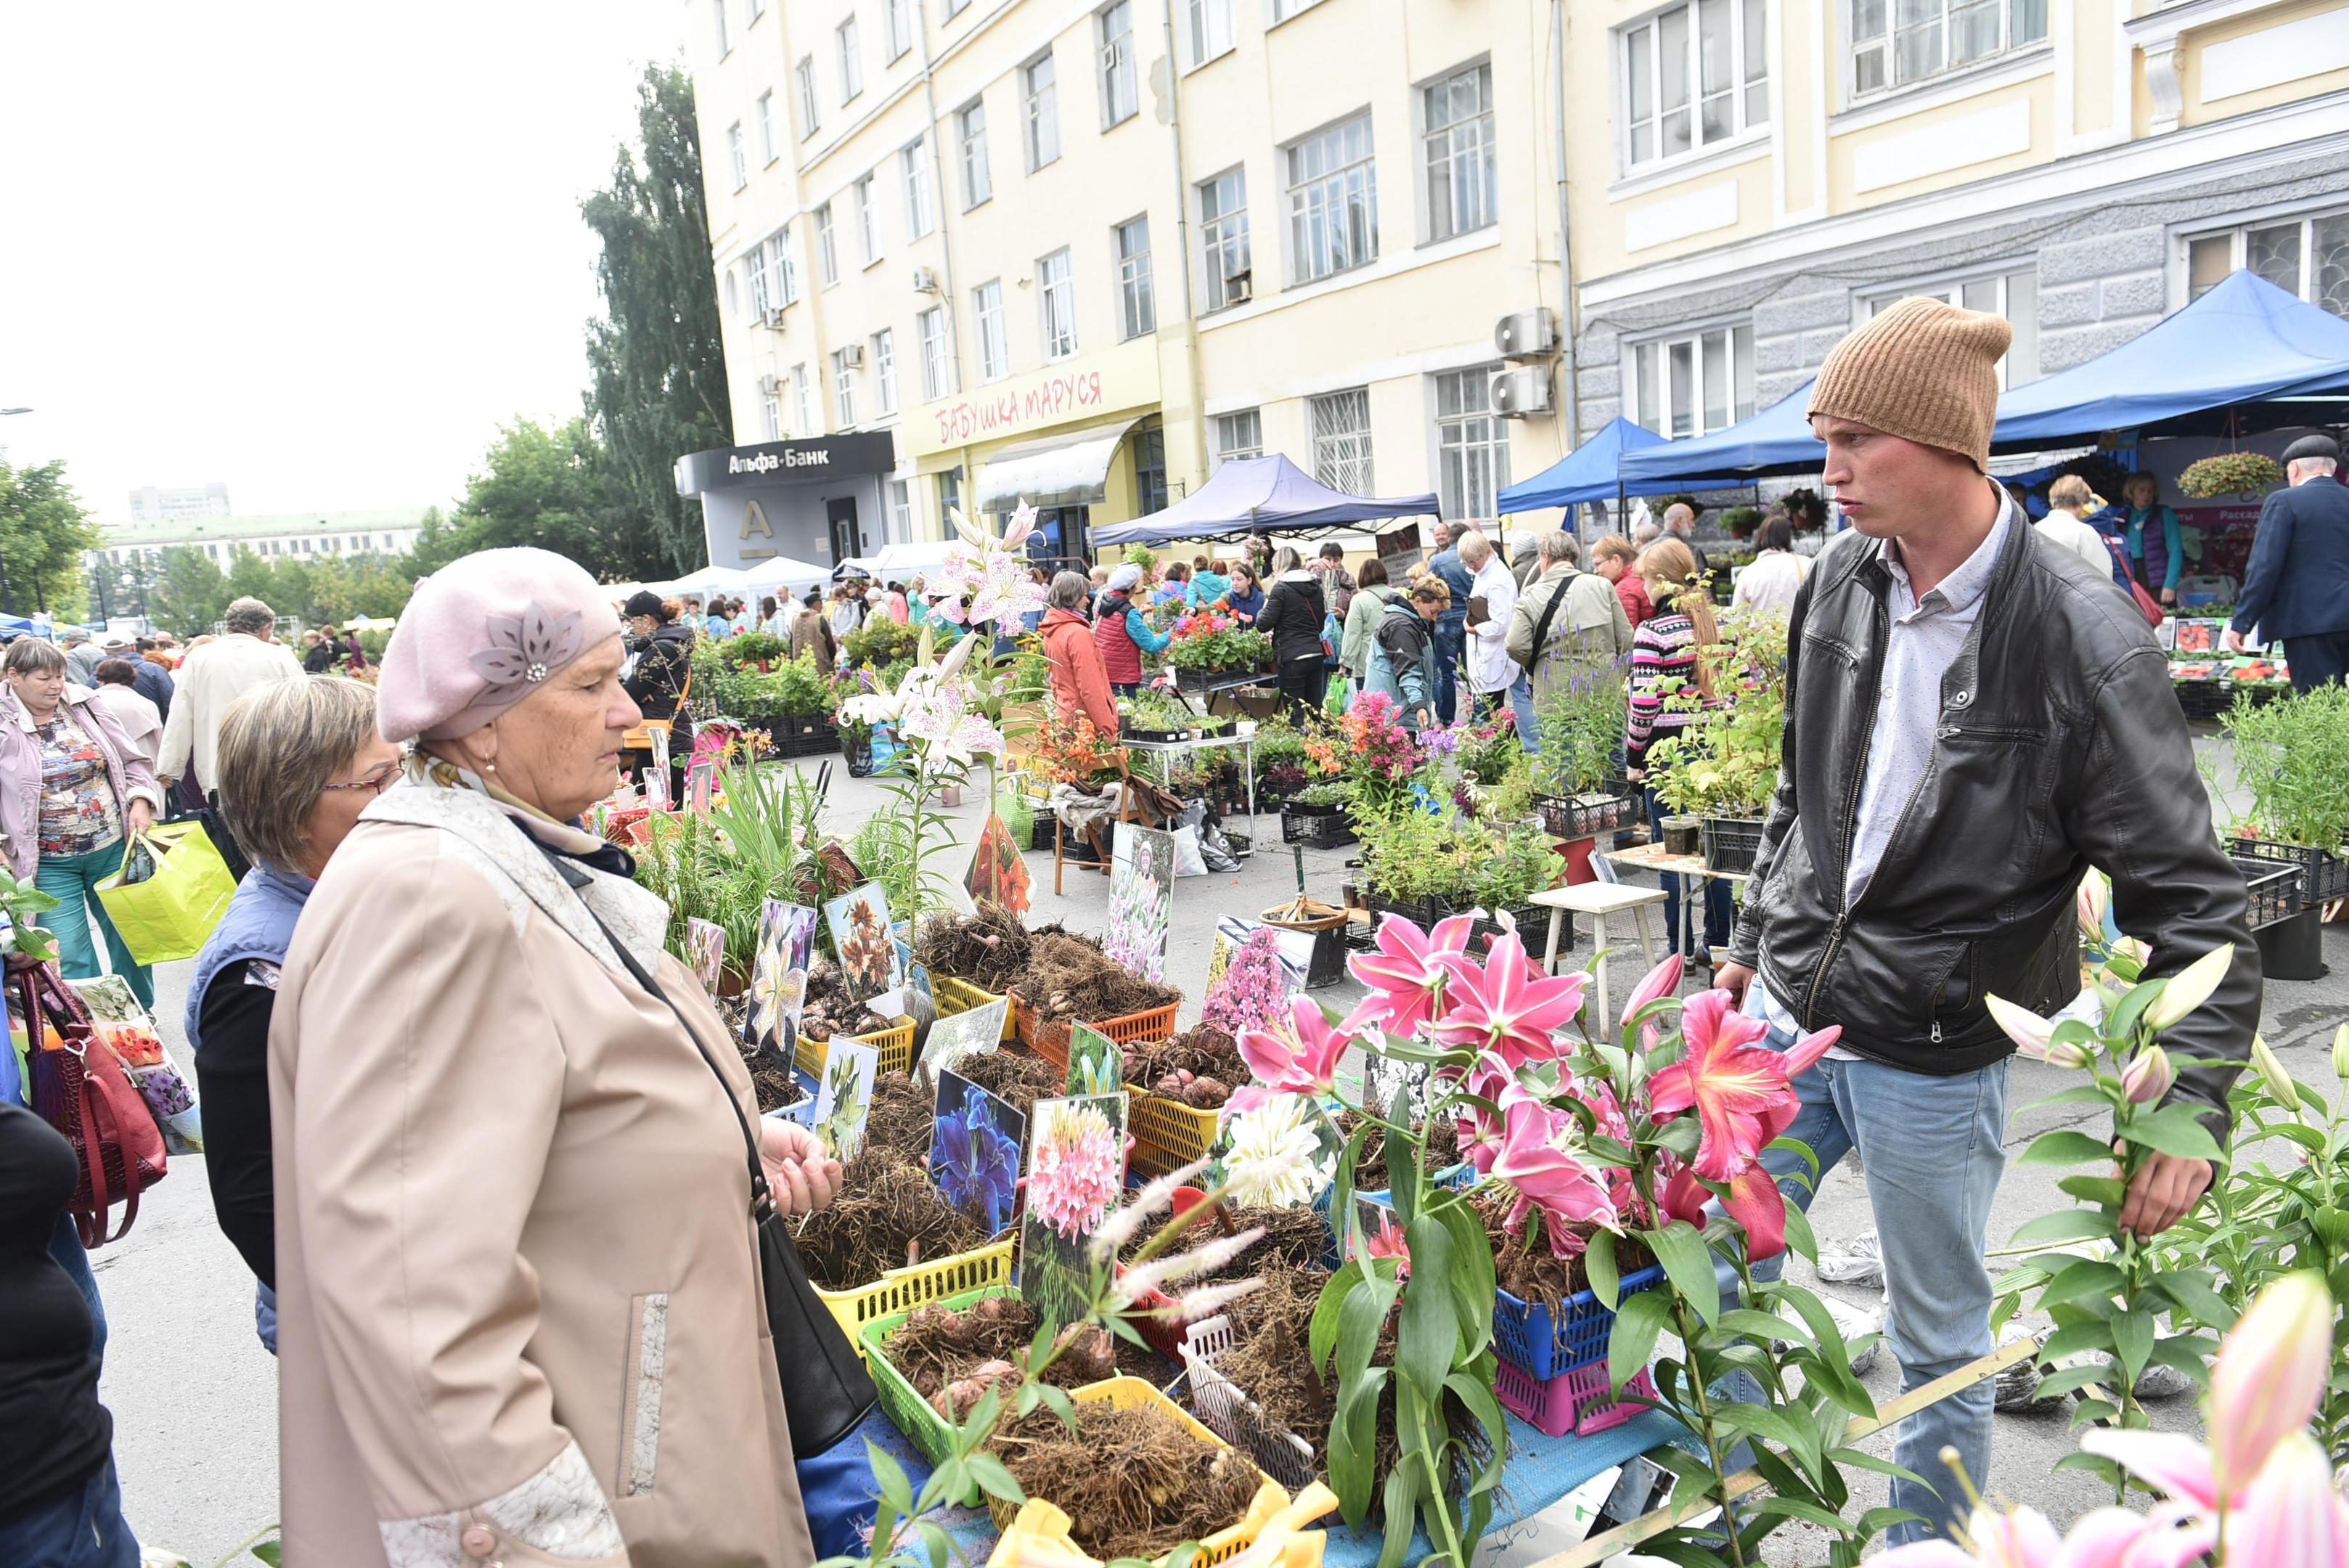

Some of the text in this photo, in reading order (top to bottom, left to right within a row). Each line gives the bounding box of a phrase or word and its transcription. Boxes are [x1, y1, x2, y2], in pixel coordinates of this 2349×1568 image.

[936, 371, 1102, 444] БАБУШКА МАРУСЯ
[2220, 510, 2261, 520] Рассад
